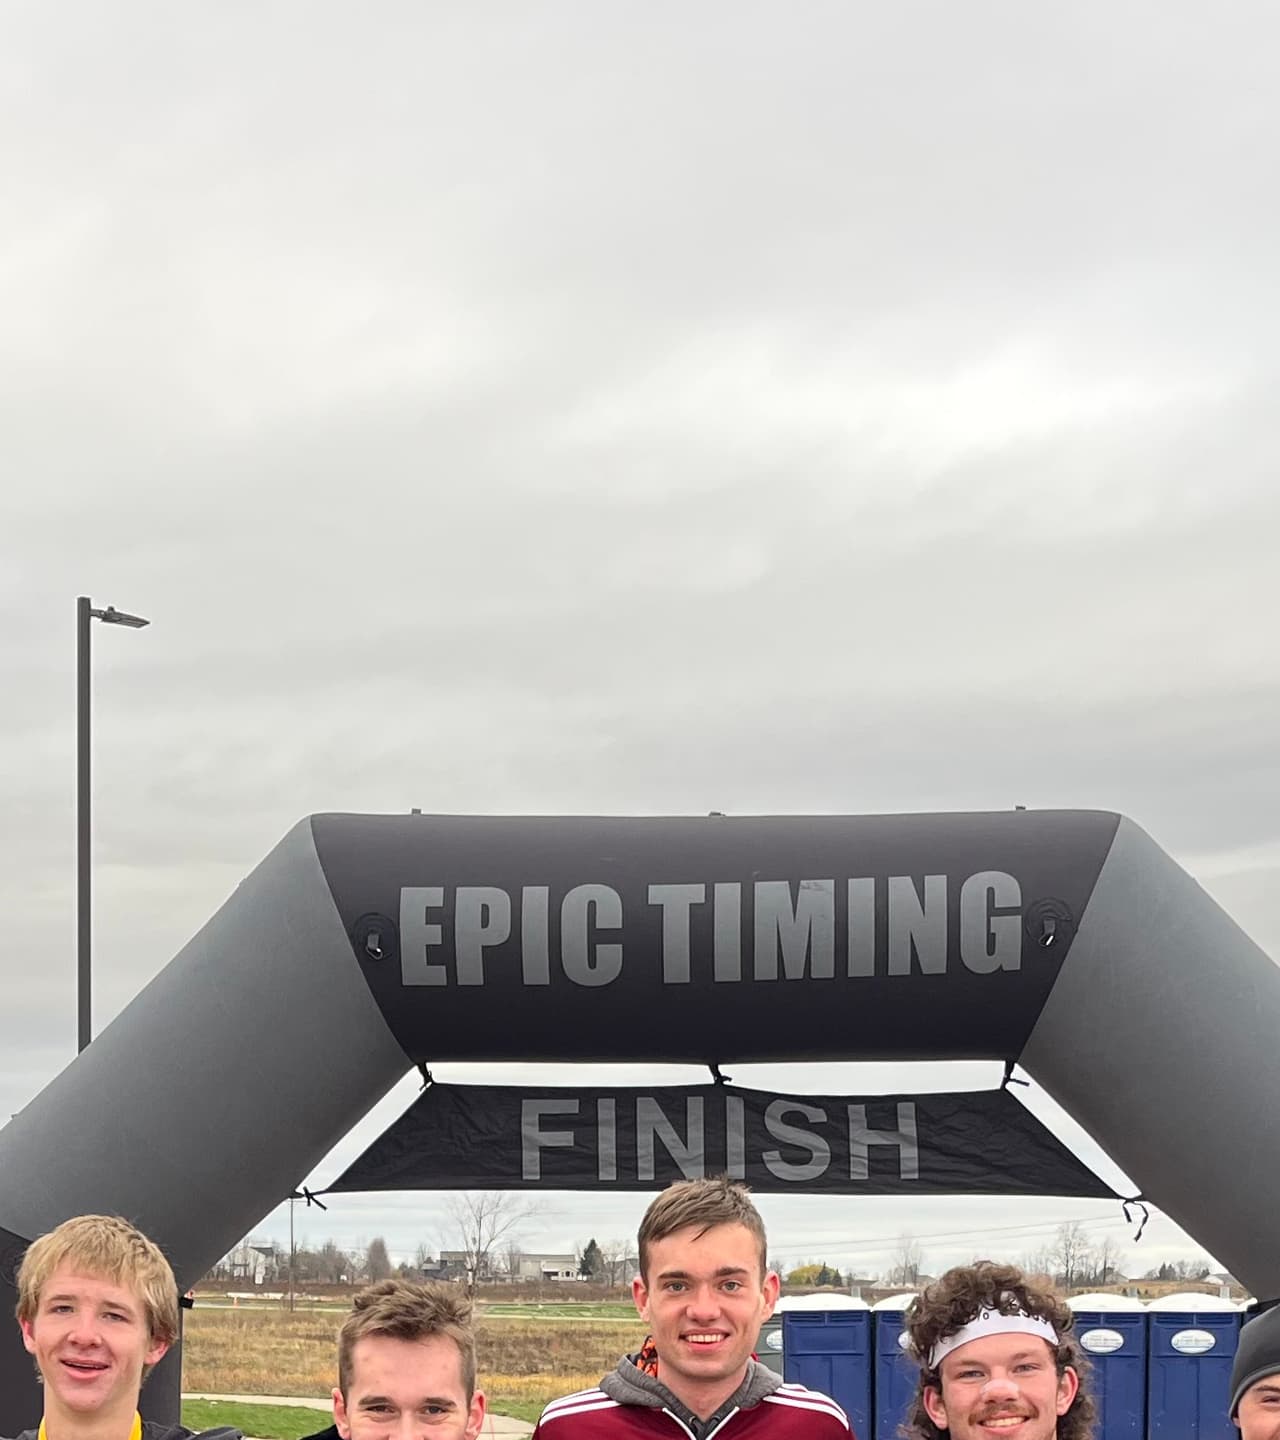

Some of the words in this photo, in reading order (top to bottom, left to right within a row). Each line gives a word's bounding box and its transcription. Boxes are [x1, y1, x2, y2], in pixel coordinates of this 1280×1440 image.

[400, 883, 623, 987] EPIC
[648, 871, 1021, 984] TIMING
[521, 1096, 920, 1181] FINISH
